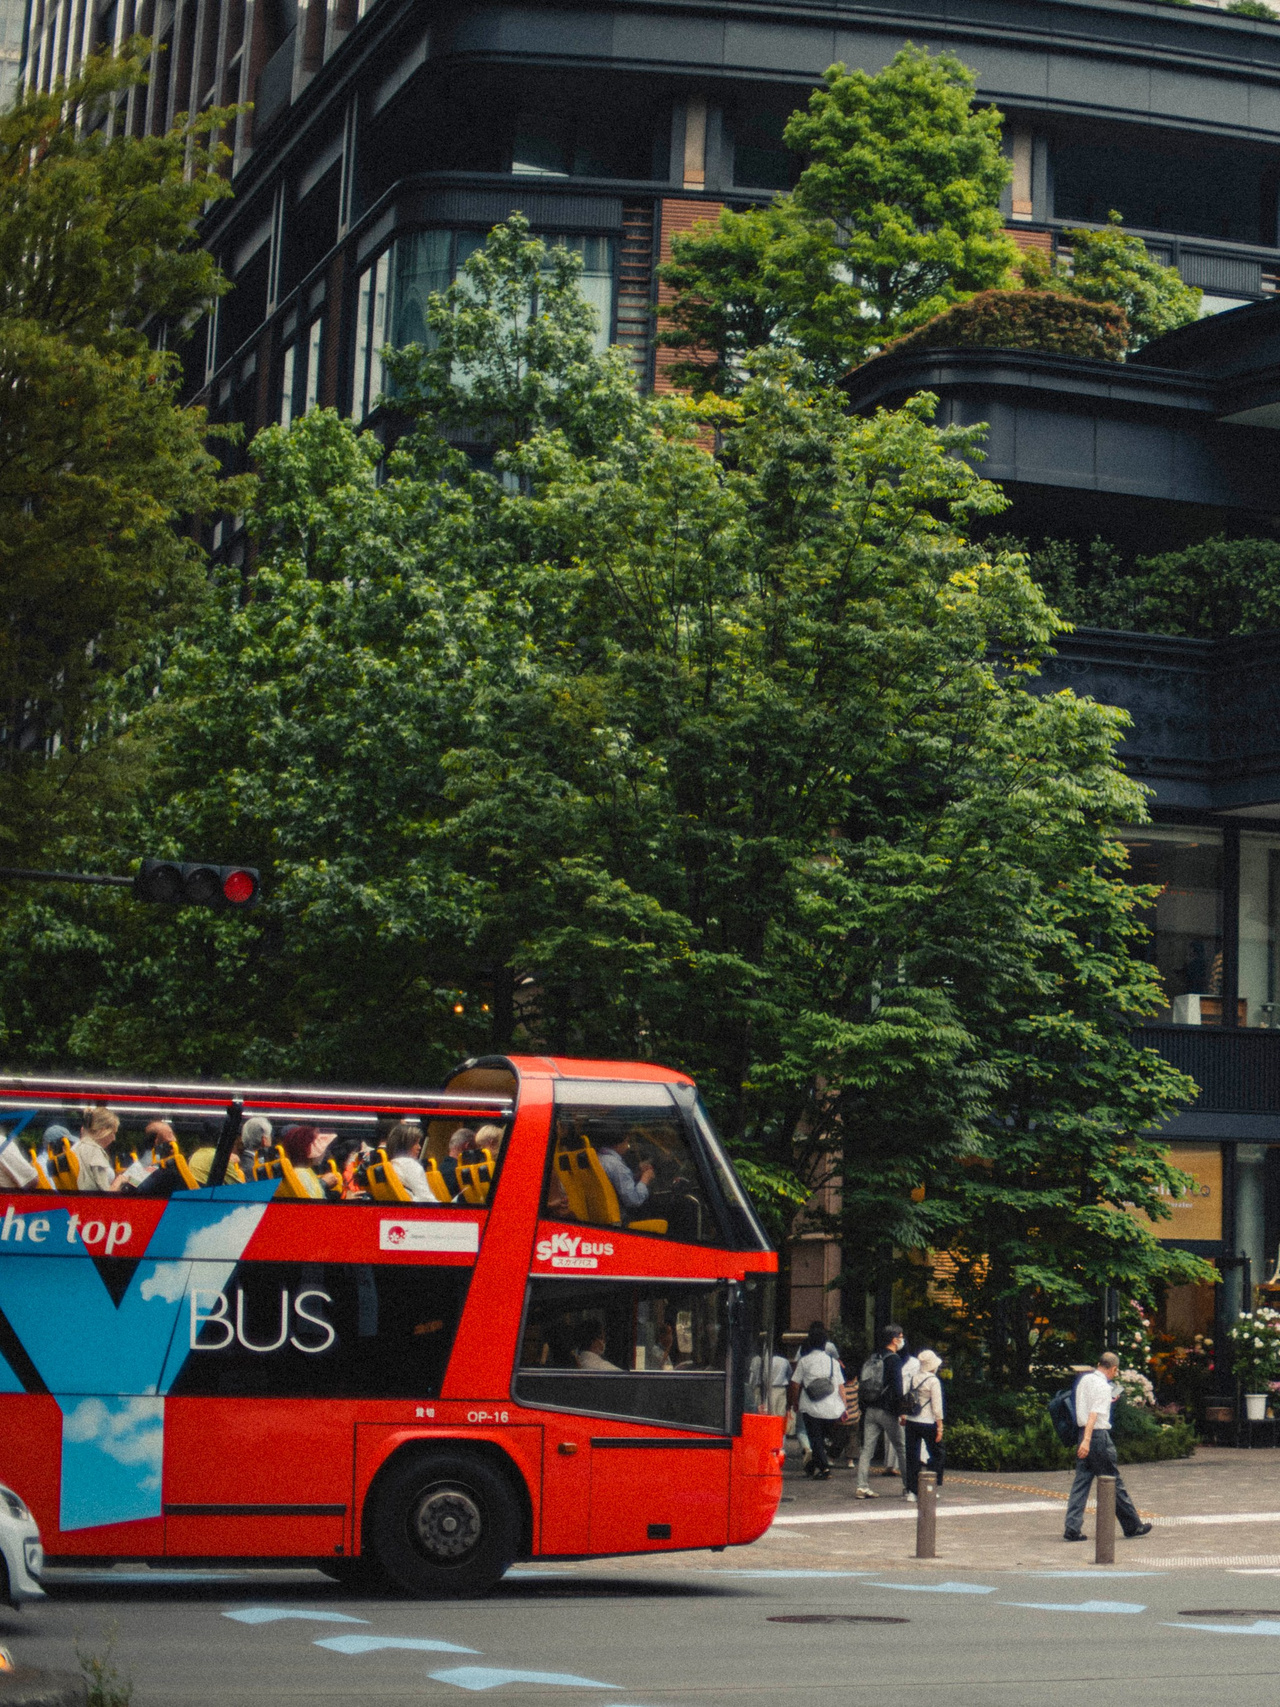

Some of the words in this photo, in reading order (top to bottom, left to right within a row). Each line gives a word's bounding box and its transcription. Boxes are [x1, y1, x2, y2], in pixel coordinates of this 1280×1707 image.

[66, 1213, 132, 1255] top
[536, 1232, 582, 1261] SKY
[581, 1242, 614, 1256] BUS
[190, 1288, 335, 1353] BUS
[467, 1411, 509, 1423] OP-16
